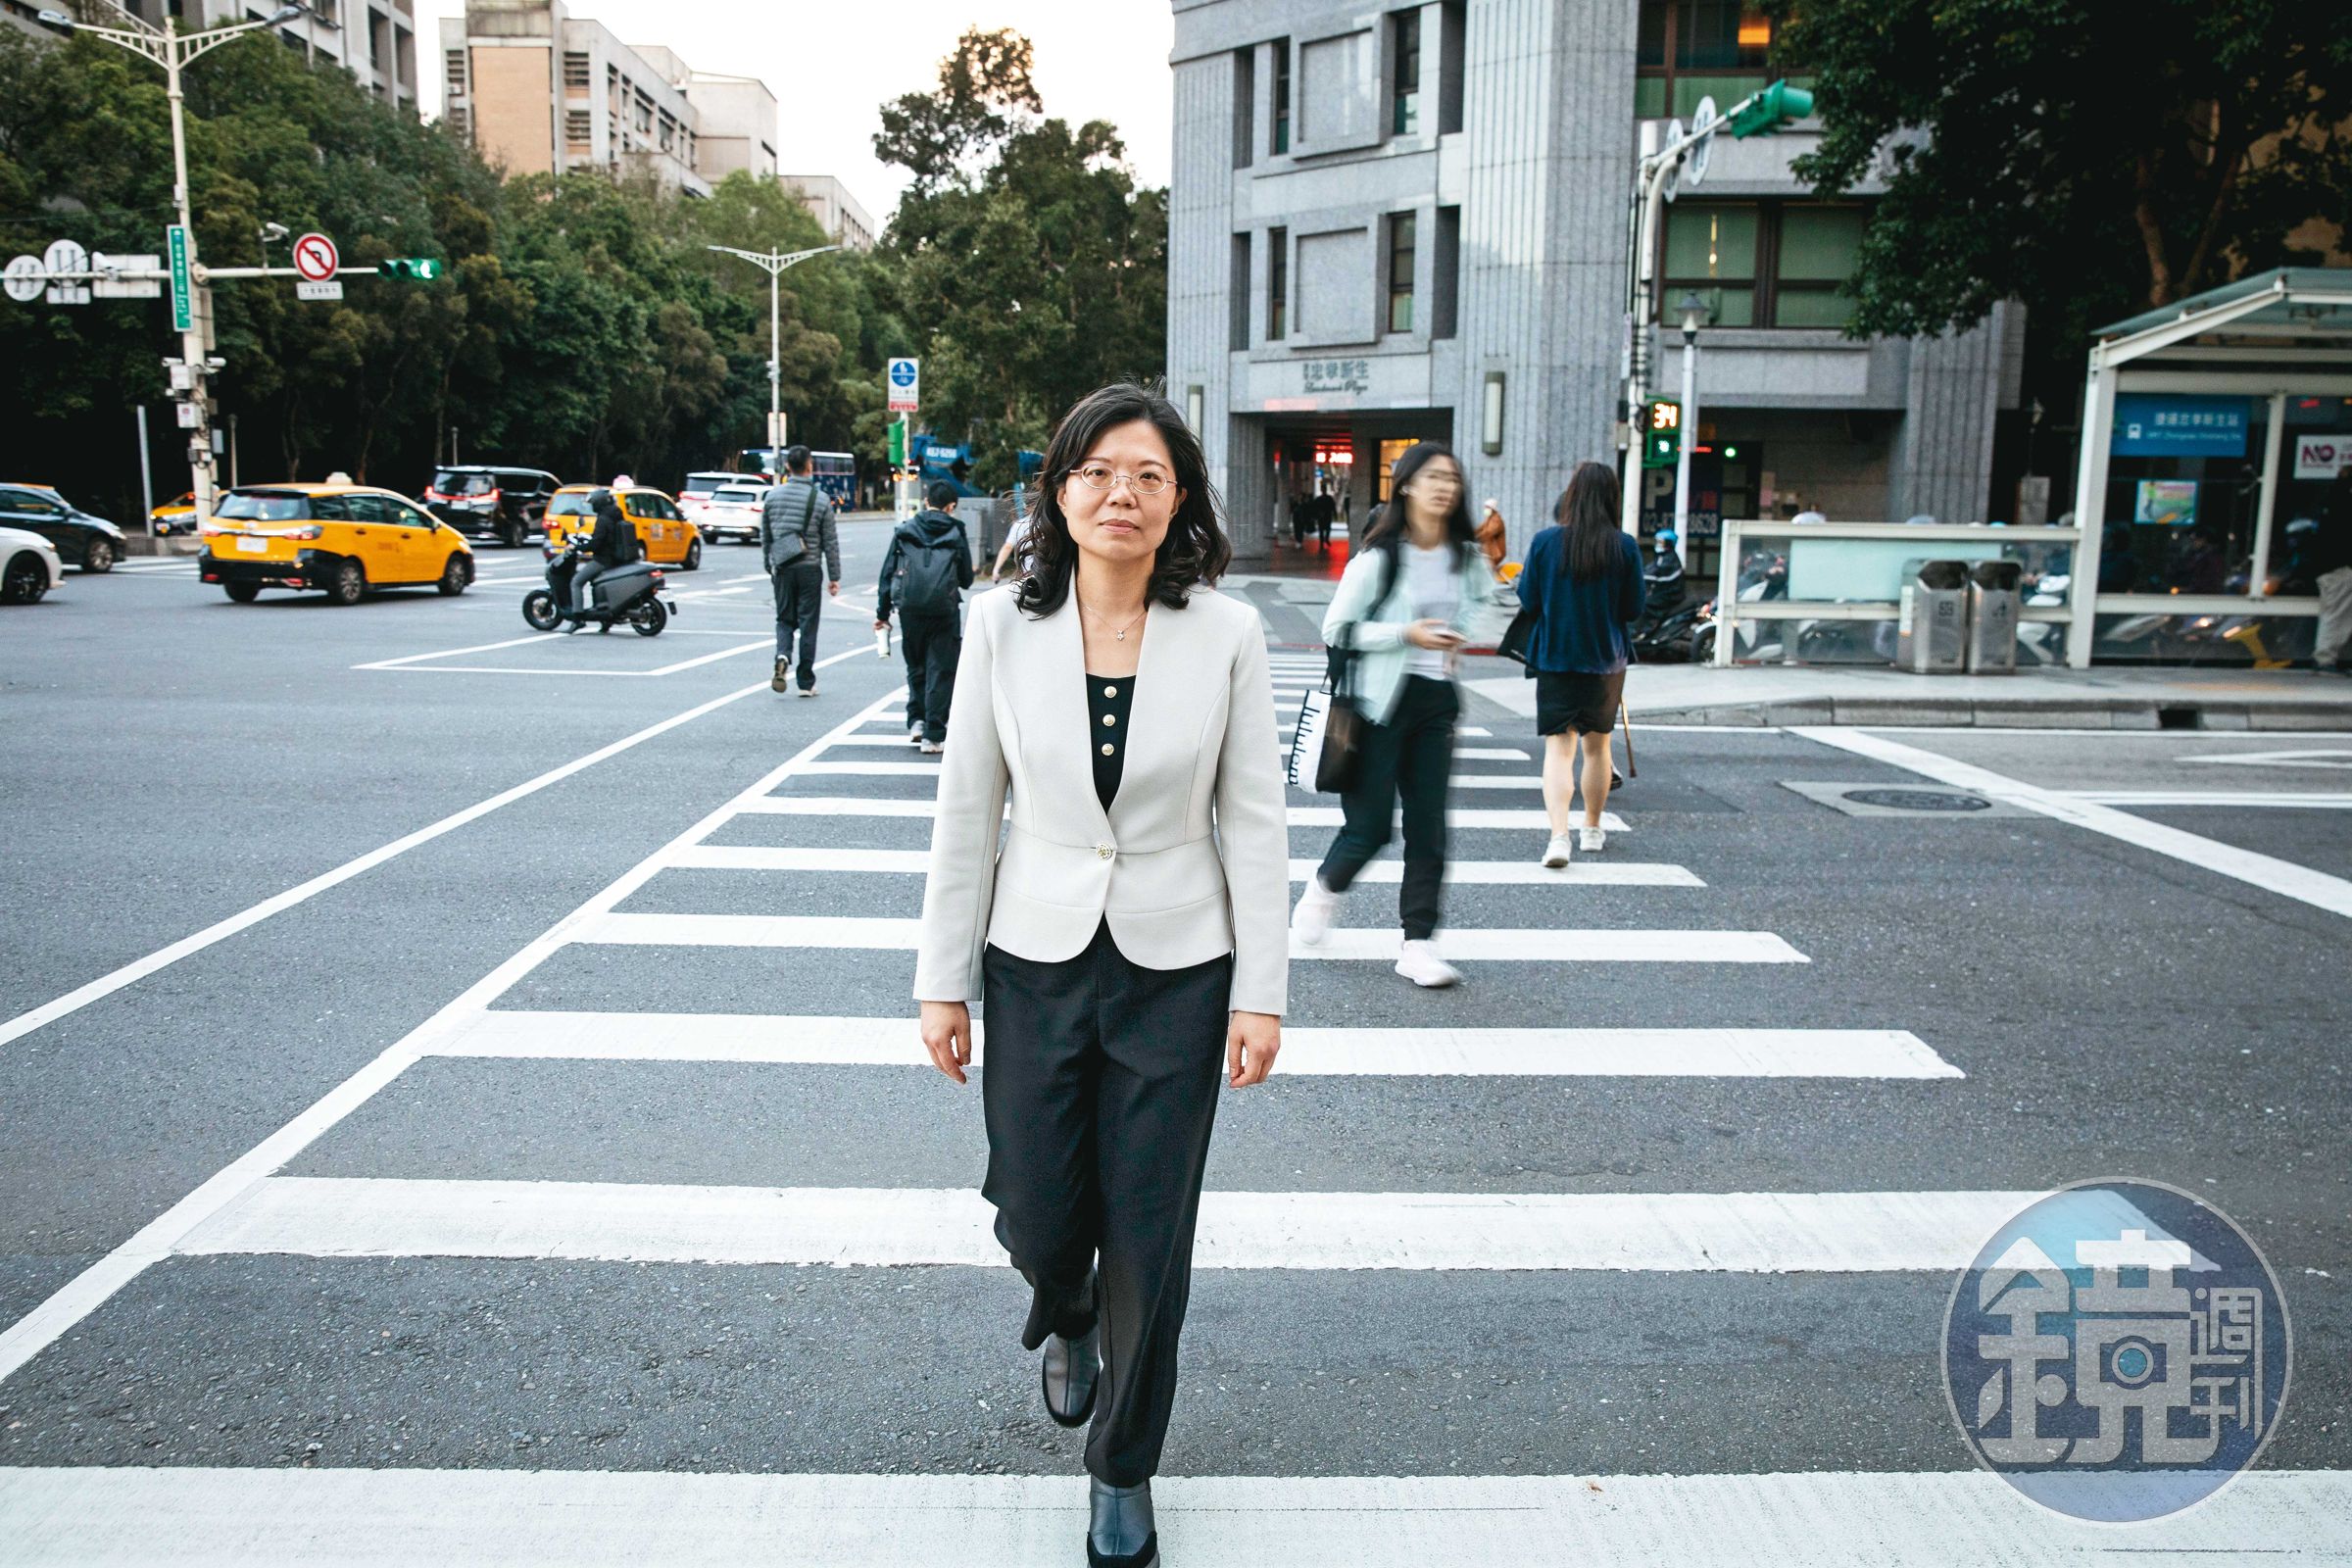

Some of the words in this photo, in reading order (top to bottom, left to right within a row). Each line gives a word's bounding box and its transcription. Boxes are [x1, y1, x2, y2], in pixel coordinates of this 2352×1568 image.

[1653, 403, 1678, 429] 34
[2302, 444, 2335, 463] NO
[1645, 468, 1674, 509] P
